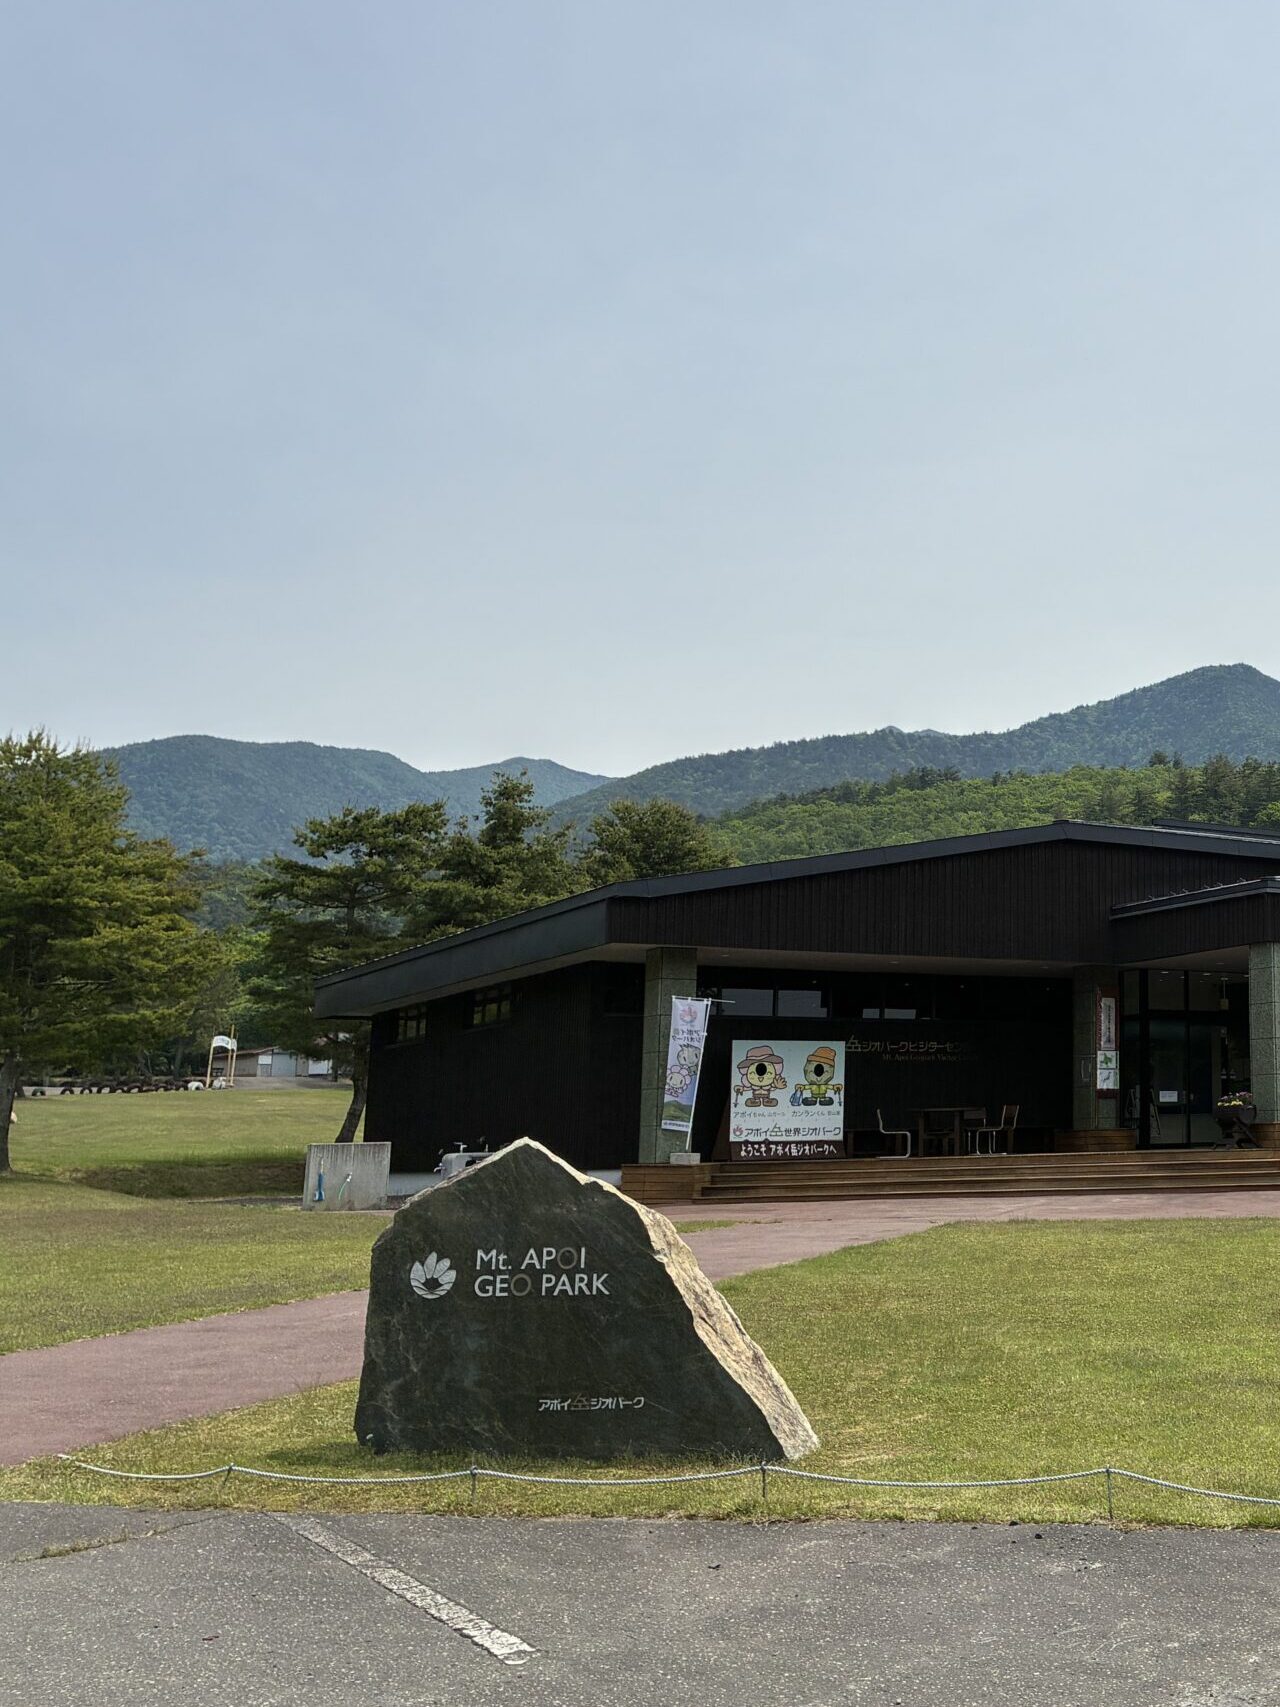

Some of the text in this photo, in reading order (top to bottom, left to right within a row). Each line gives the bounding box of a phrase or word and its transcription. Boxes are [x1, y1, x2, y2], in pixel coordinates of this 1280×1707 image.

[744, 1122, 842, 1137] アポイ岳世界ジオパーク
[740, 1143, 767, 1157] ようこそ
[475, 1246, 586, 1270] Mt. APOI
[474, 1273, 611, 1297] GEO PARK
[538, 1393, 645, 1411] アポイ岳ジオパーク
